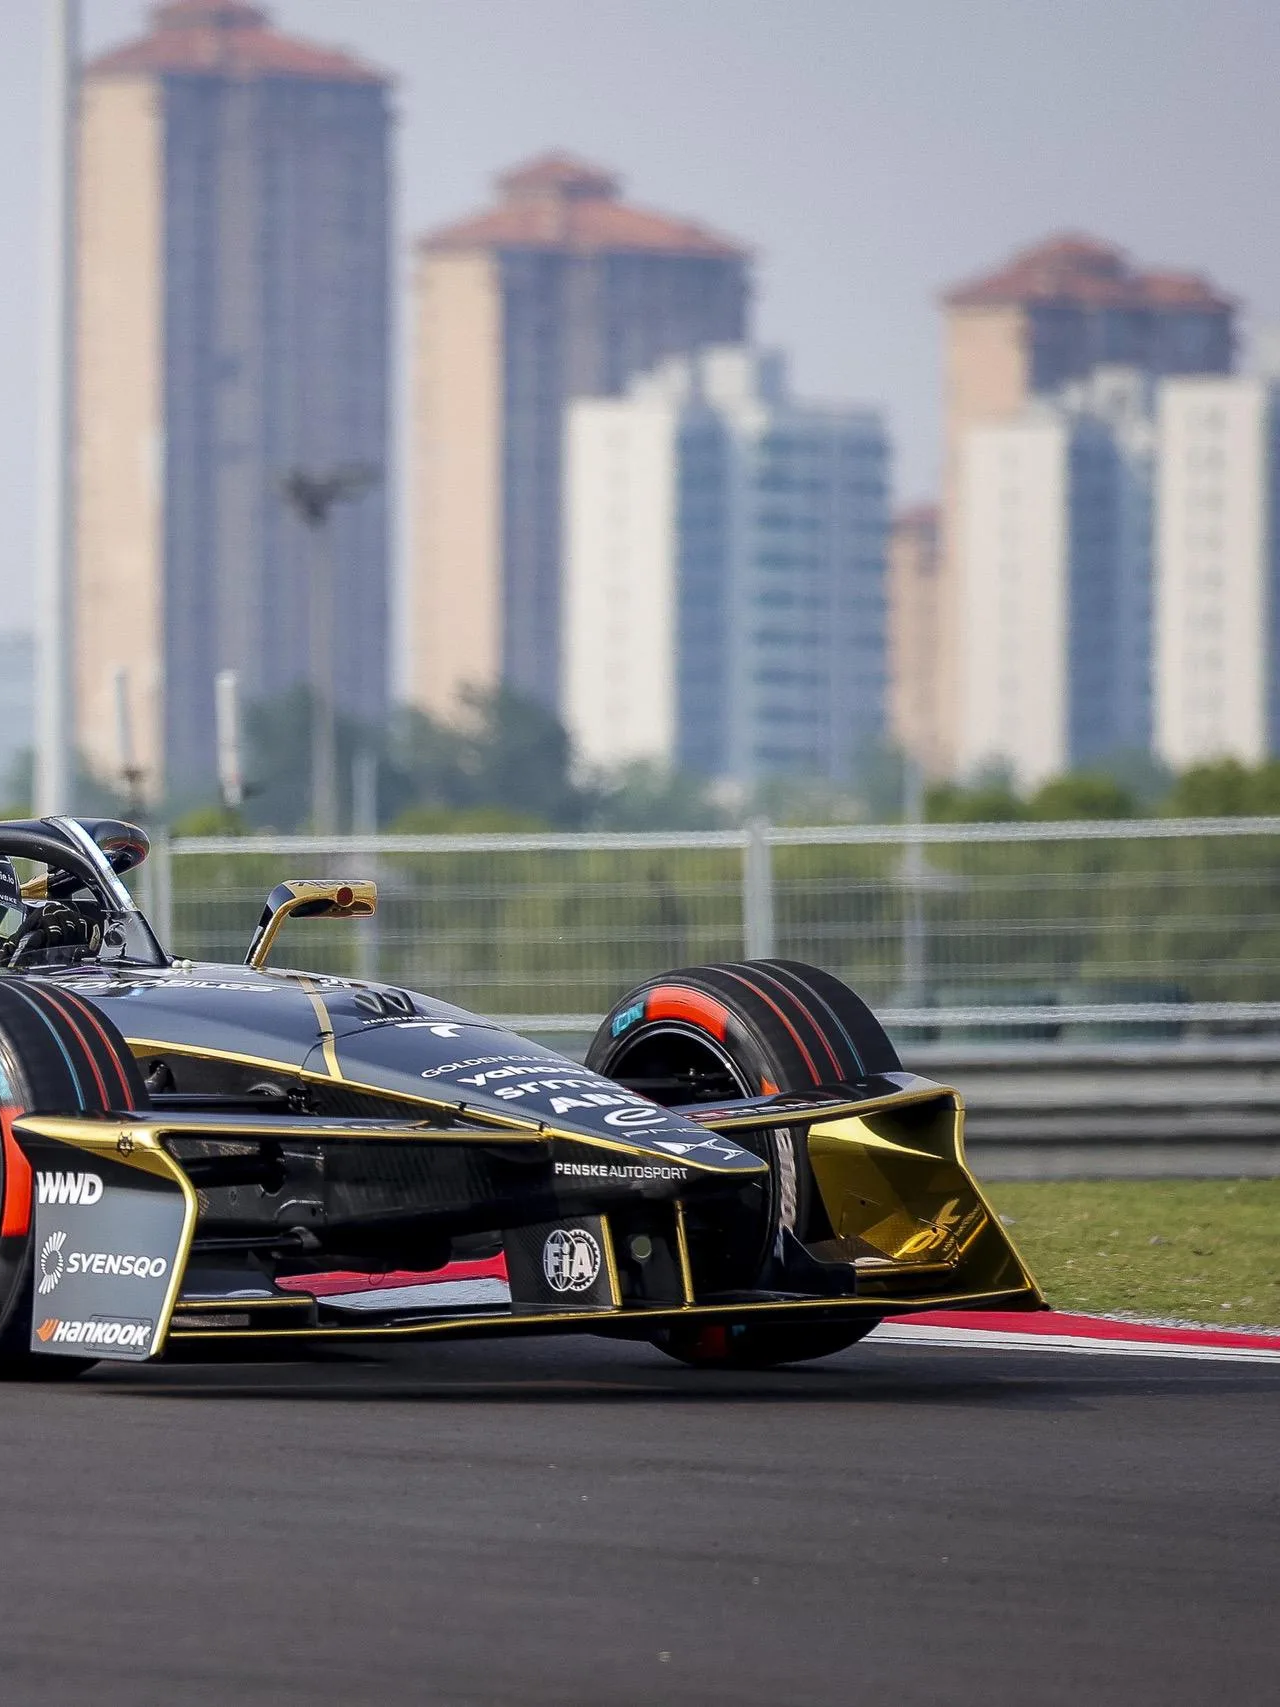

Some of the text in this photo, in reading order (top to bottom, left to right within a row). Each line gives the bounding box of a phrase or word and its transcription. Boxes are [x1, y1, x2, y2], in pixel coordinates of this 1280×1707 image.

[421, 1056, 506, 1078] GOLDEN
[36, 1171, 104, 1206] WWD
[66, 1252, 168, 1278] SYENSQO
